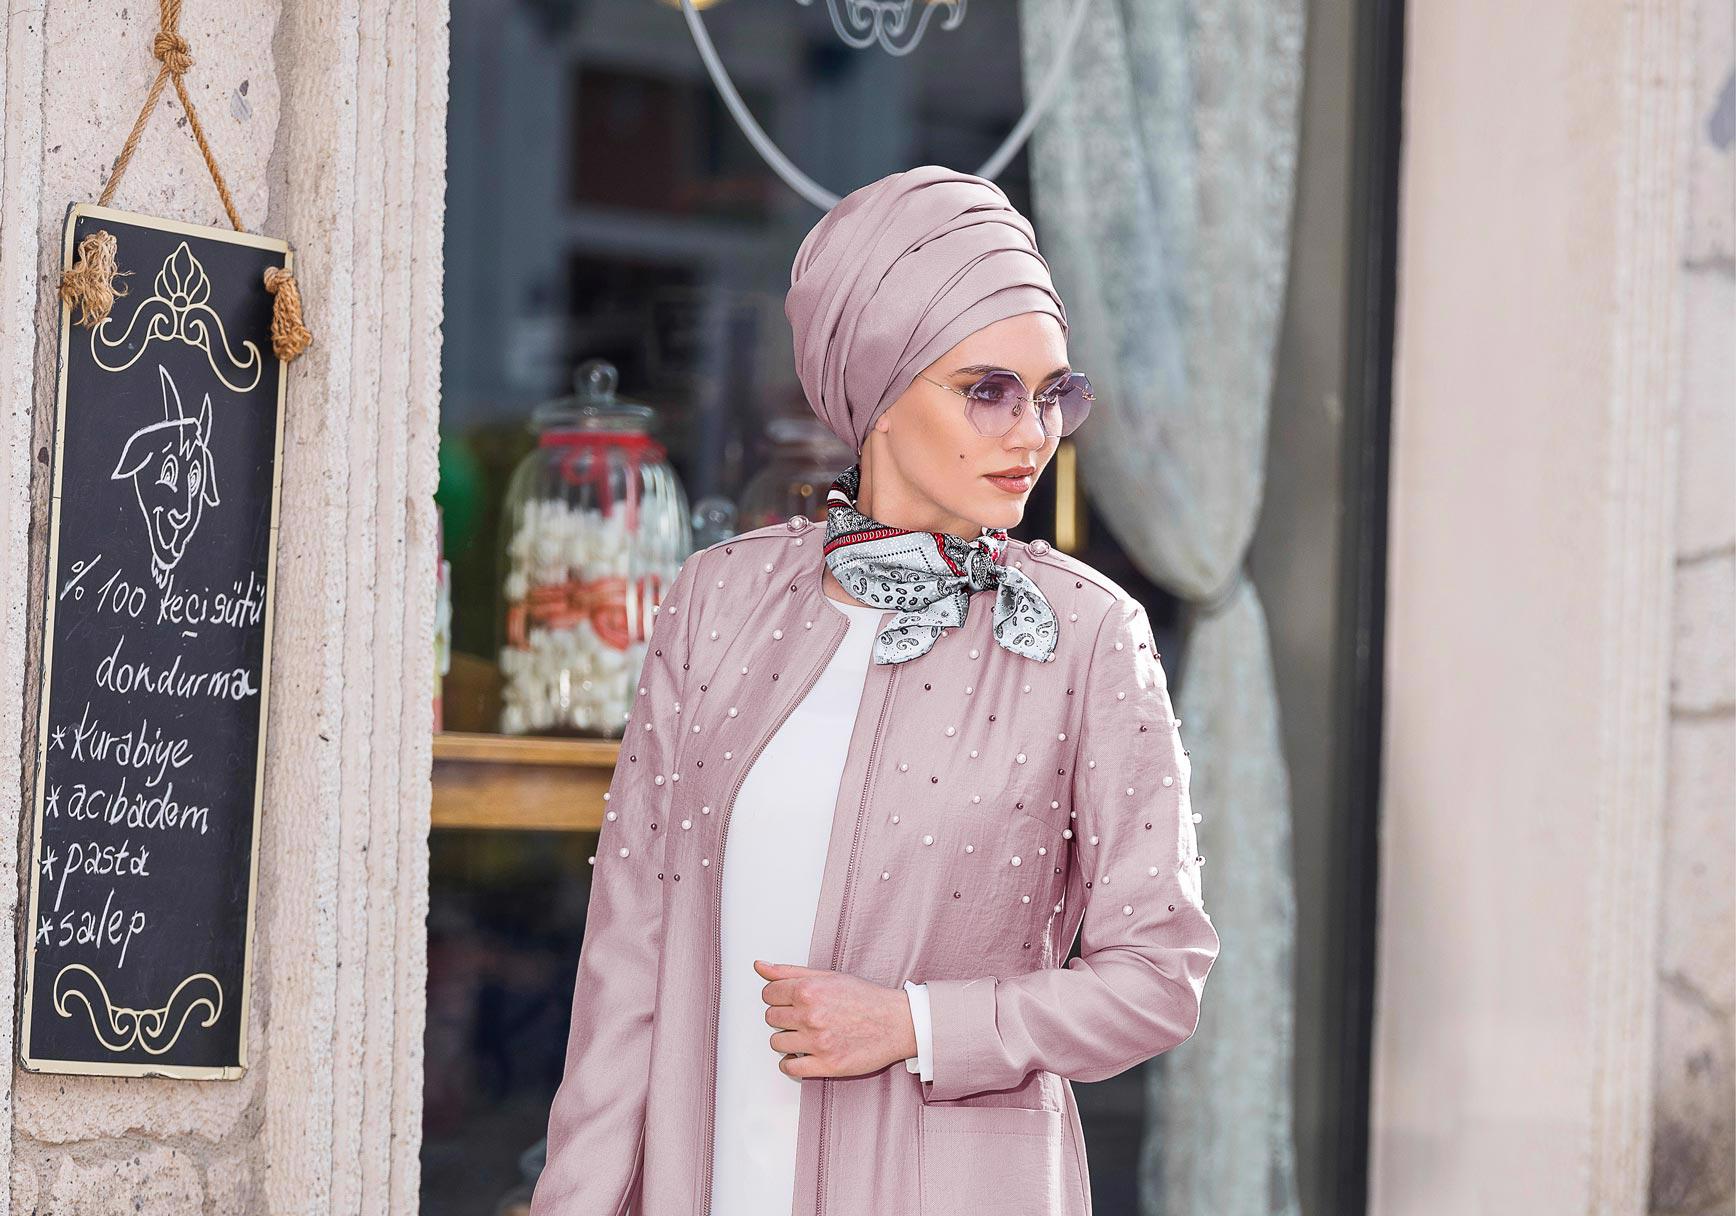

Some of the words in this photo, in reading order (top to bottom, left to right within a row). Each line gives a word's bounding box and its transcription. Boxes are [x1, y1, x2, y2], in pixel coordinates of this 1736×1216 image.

[97, 568, 147, 618] 100
[96, 634, 258, 700] dondurma
[54, 839, 150, 912] pasta
[58, 888, 146, 968] salep
